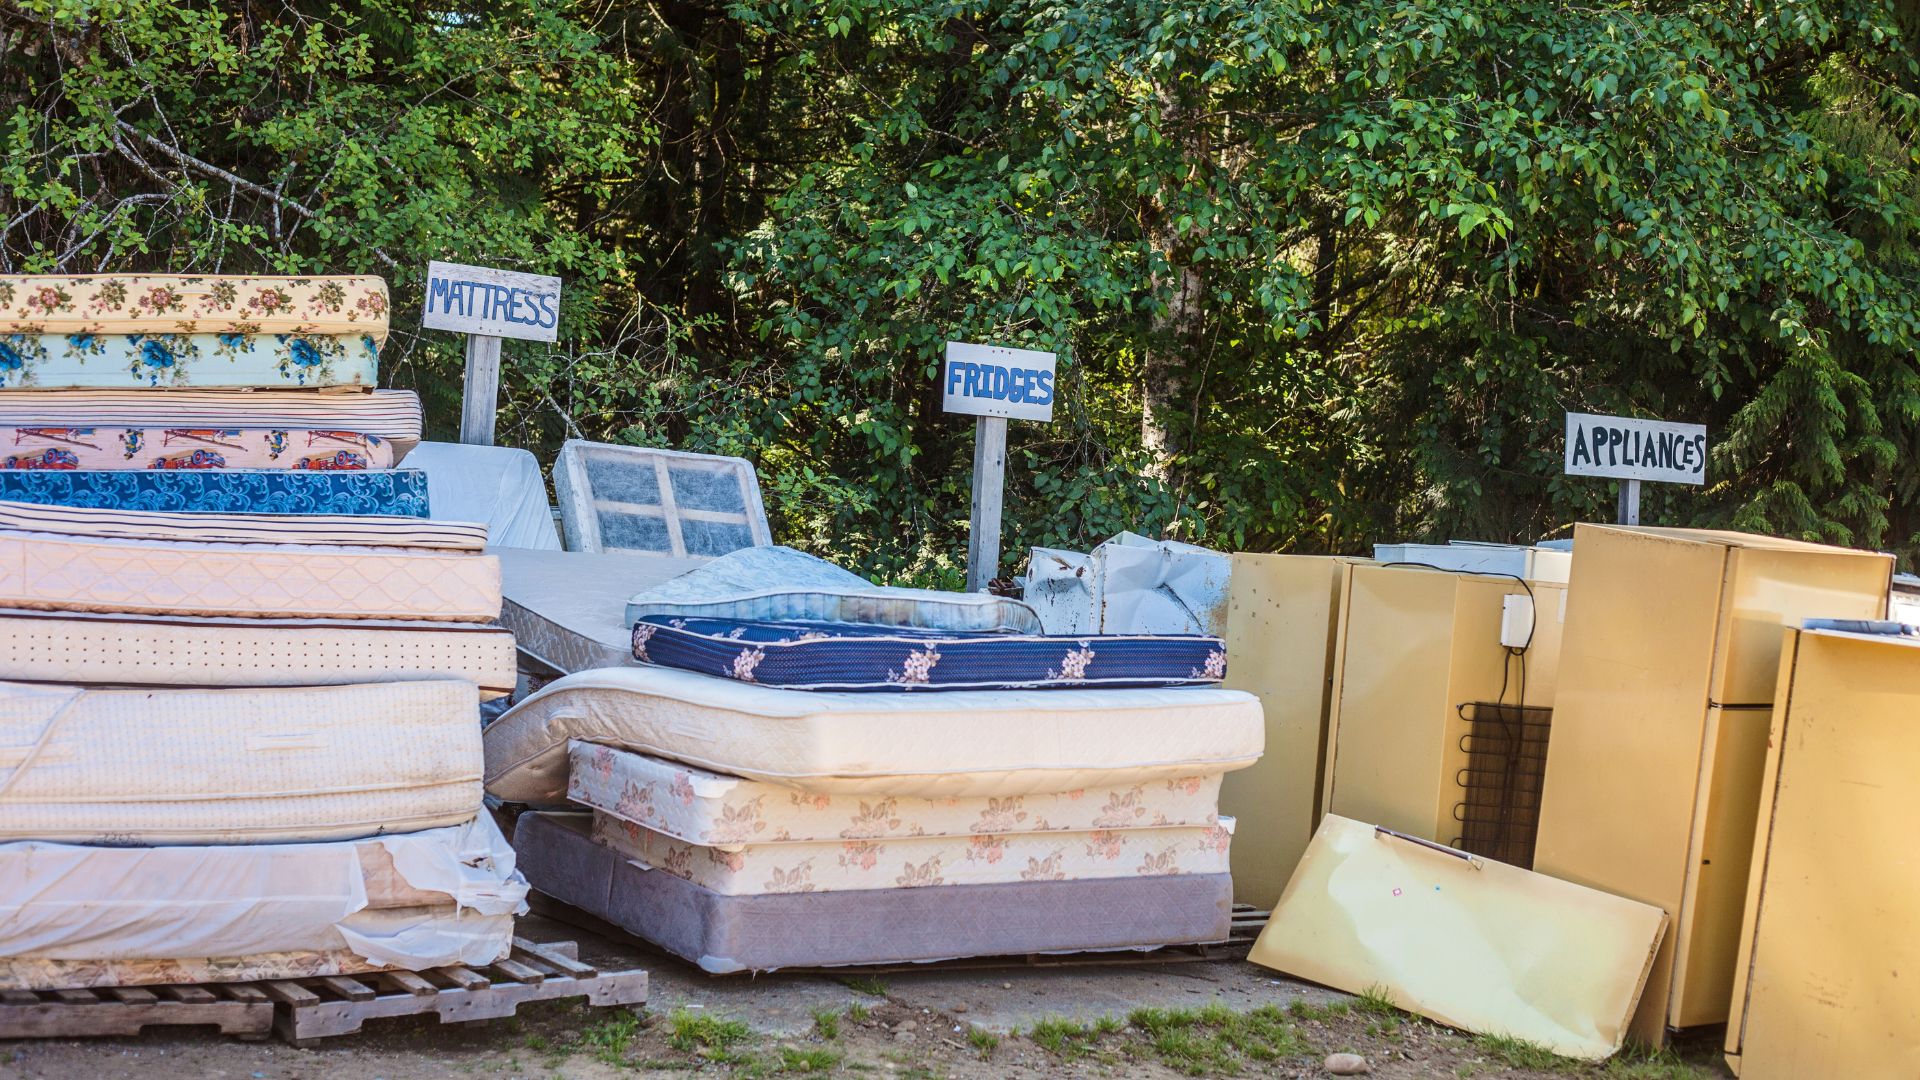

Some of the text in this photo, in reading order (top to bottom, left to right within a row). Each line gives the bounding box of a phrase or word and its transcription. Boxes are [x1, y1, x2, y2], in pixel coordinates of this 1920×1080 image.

[428, 277, 557, 328] MATTRESS
[947, 361, 1053, 405] FRIDGES
[1572, 423, 1705, 473] APPLIANCES
